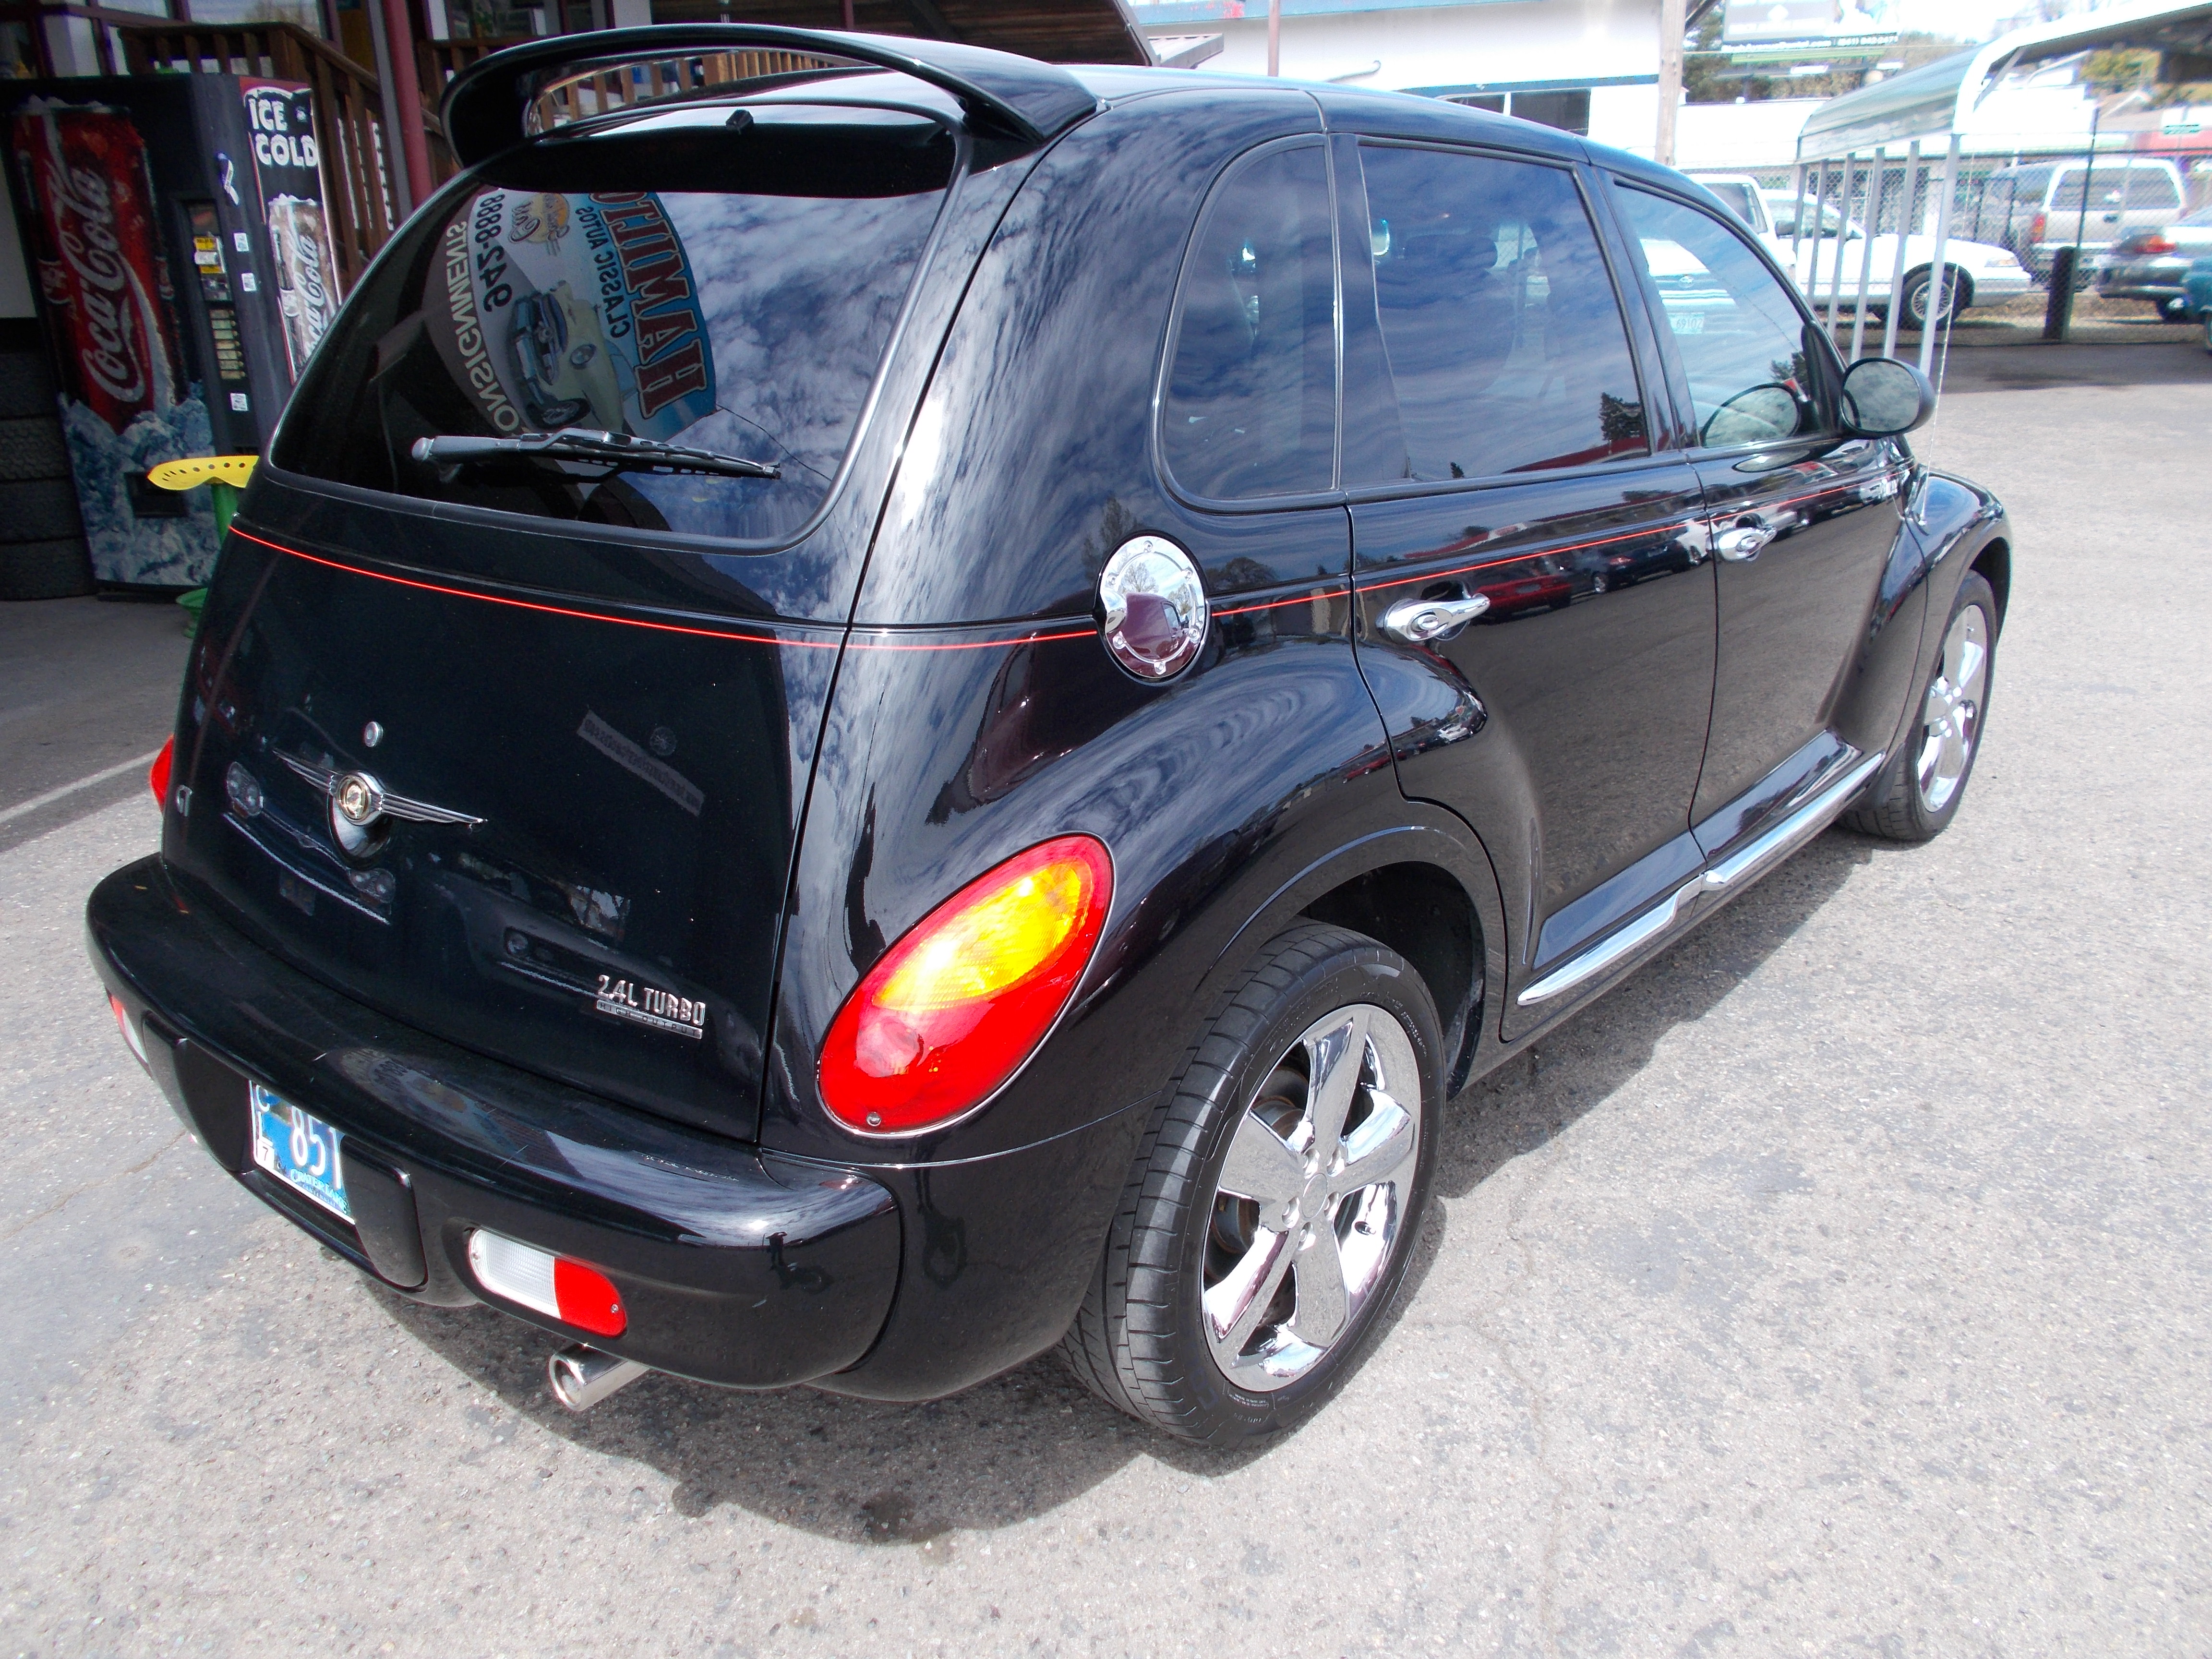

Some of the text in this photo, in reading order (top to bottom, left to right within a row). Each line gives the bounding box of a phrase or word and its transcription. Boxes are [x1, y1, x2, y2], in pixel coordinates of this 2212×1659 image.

[247, 97, 288, 132] ICE
[255, 132, 318, 167] COLD
[598, 974, 706, 1026] 2.4L TURBO
[600, 1002, 697, 1037] HIGH OUTPUT
[262, 1145, 269, 1162] 7
